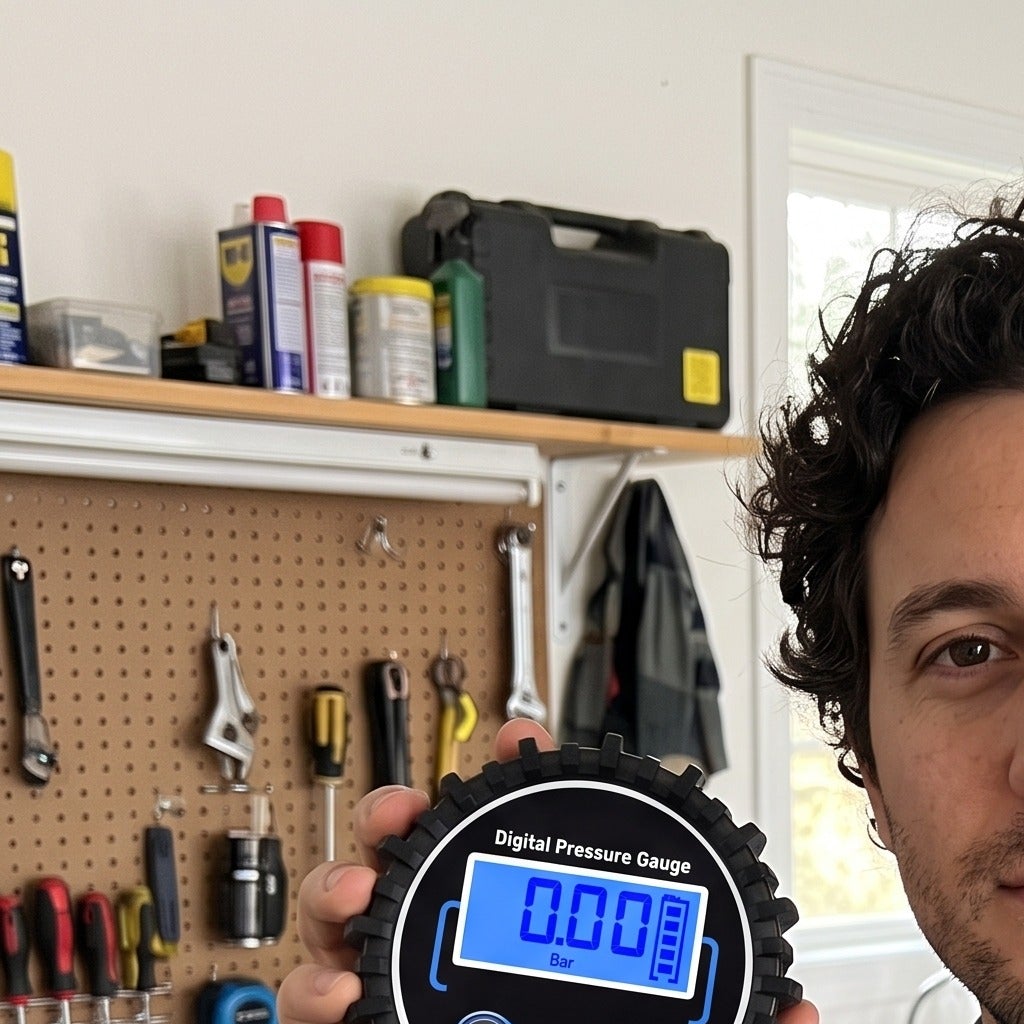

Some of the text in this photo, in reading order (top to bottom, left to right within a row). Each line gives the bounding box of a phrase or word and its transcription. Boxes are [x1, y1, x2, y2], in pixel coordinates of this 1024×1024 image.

[494, 829, 691, 876] Digital Pressure Gauge
[519, 876, 652, 957] 0.00
[550, 953, 574, 969] Bar
